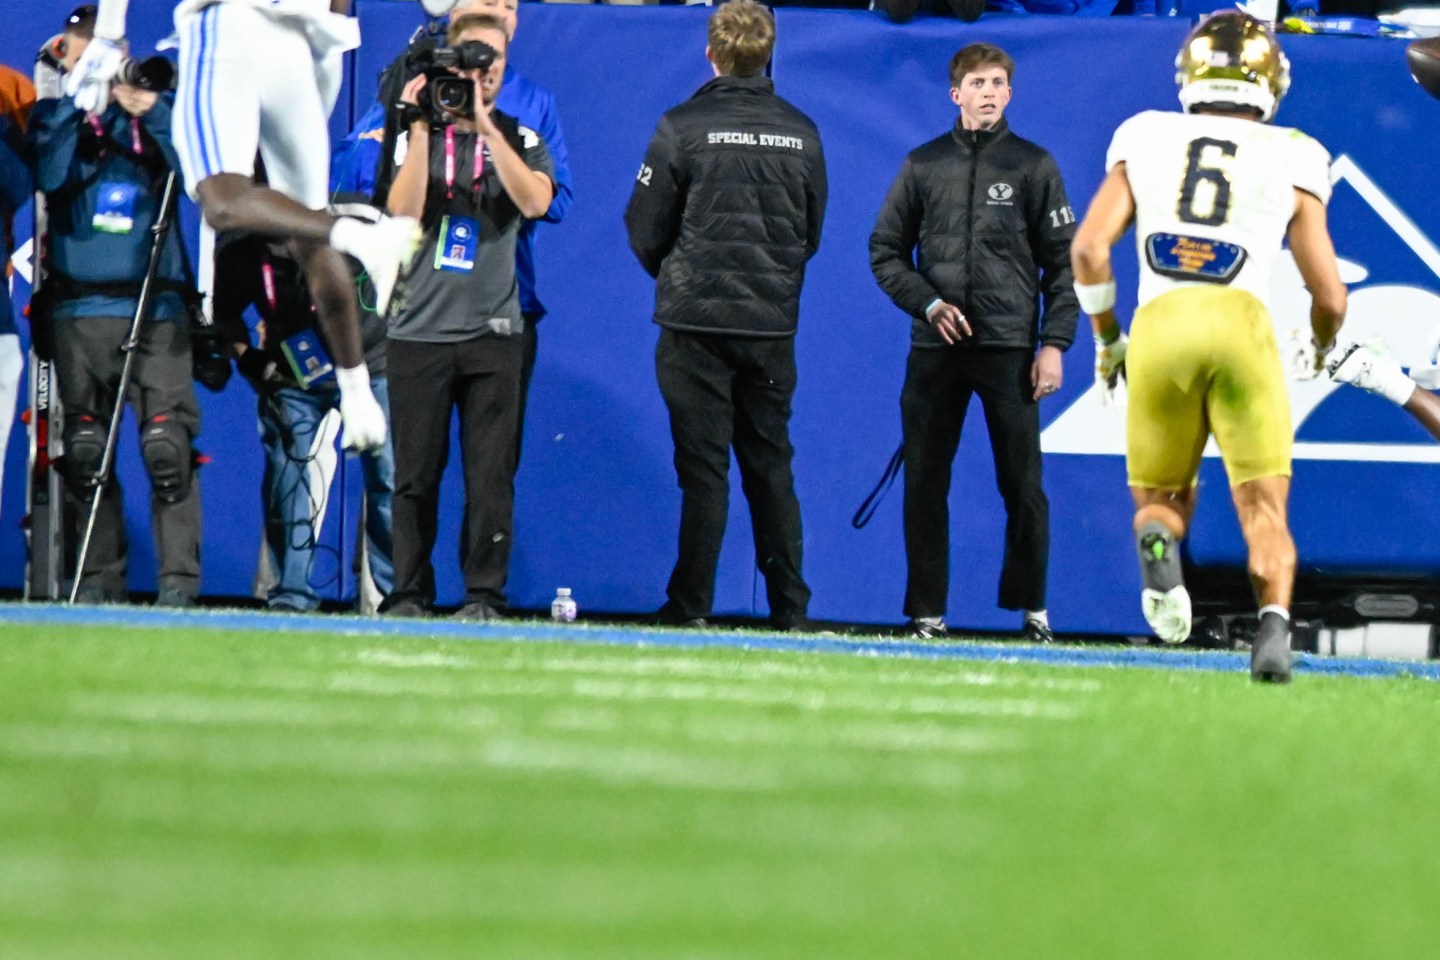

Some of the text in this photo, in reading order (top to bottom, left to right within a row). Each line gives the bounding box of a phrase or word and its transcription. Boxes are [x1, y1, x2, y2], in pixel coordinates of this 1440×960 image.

[708, 132, 804, 150] SPECIAL EVENTS
[992, 183, 1010, 200] Y
[1177, 136, 1239, 228] 6
[38, 359, 50, 411] VELOCITY
